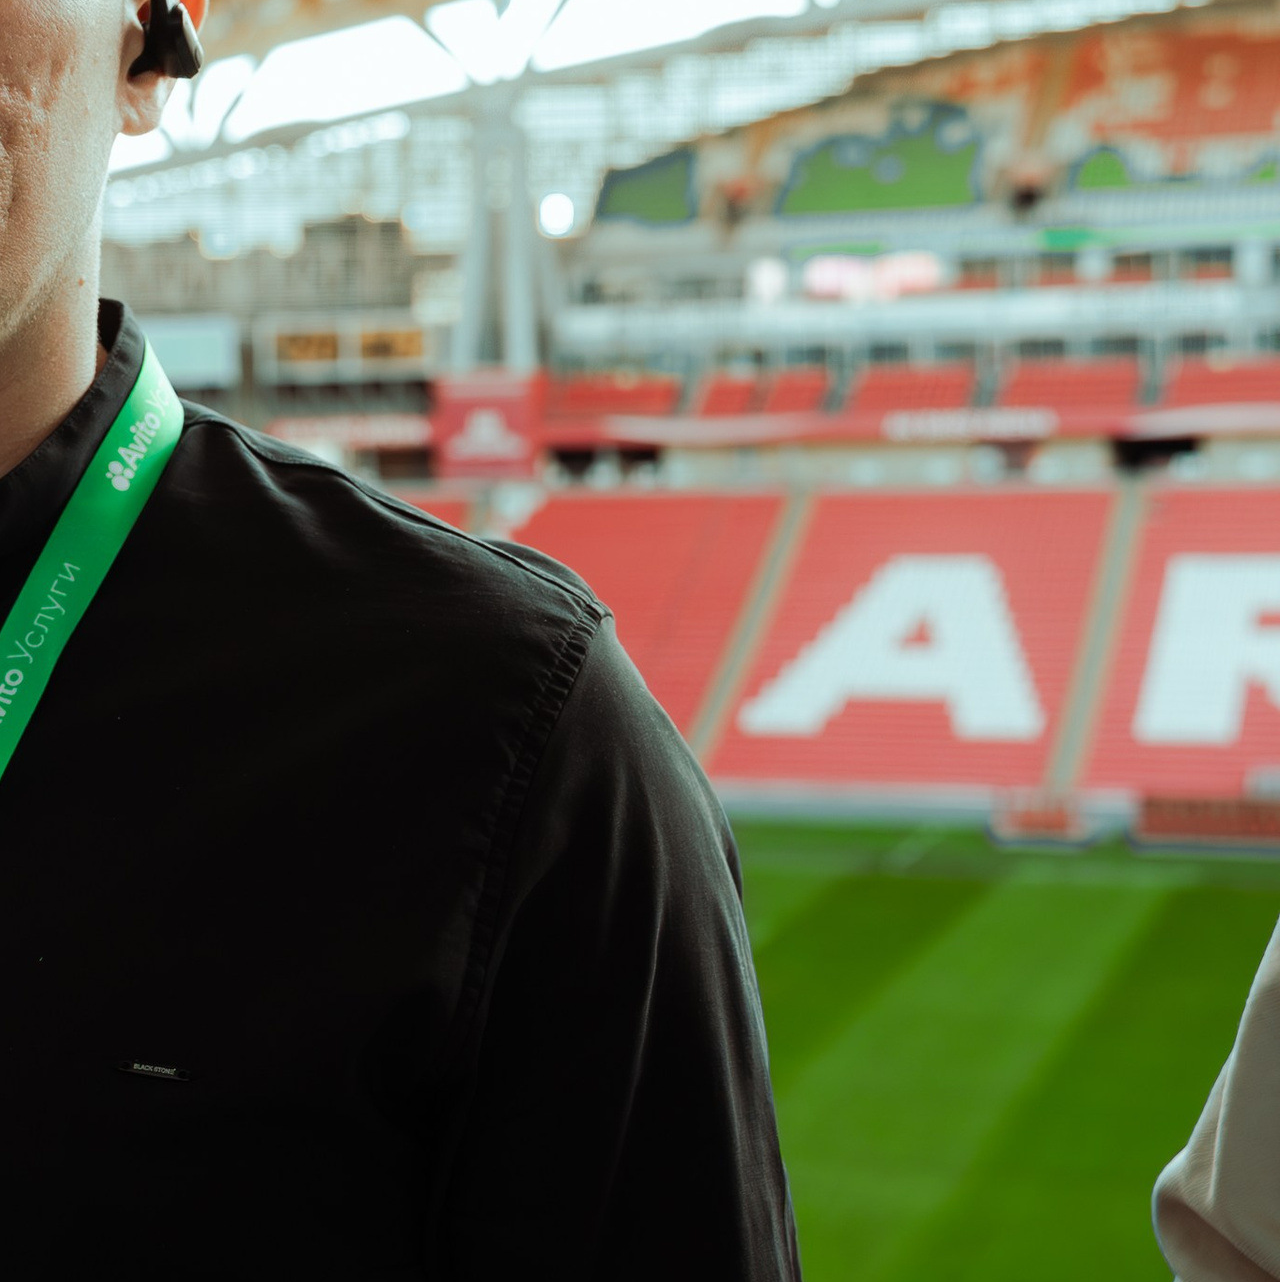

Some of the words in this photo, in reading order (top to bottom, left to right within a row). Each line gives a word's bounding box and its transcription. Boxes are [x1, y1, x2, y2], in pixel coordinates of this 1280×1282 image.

[117, 411, 160, 472] Avito
[6, 562, 81, 665] Услуги
[133, 1063, 153, 1072] BLACK
